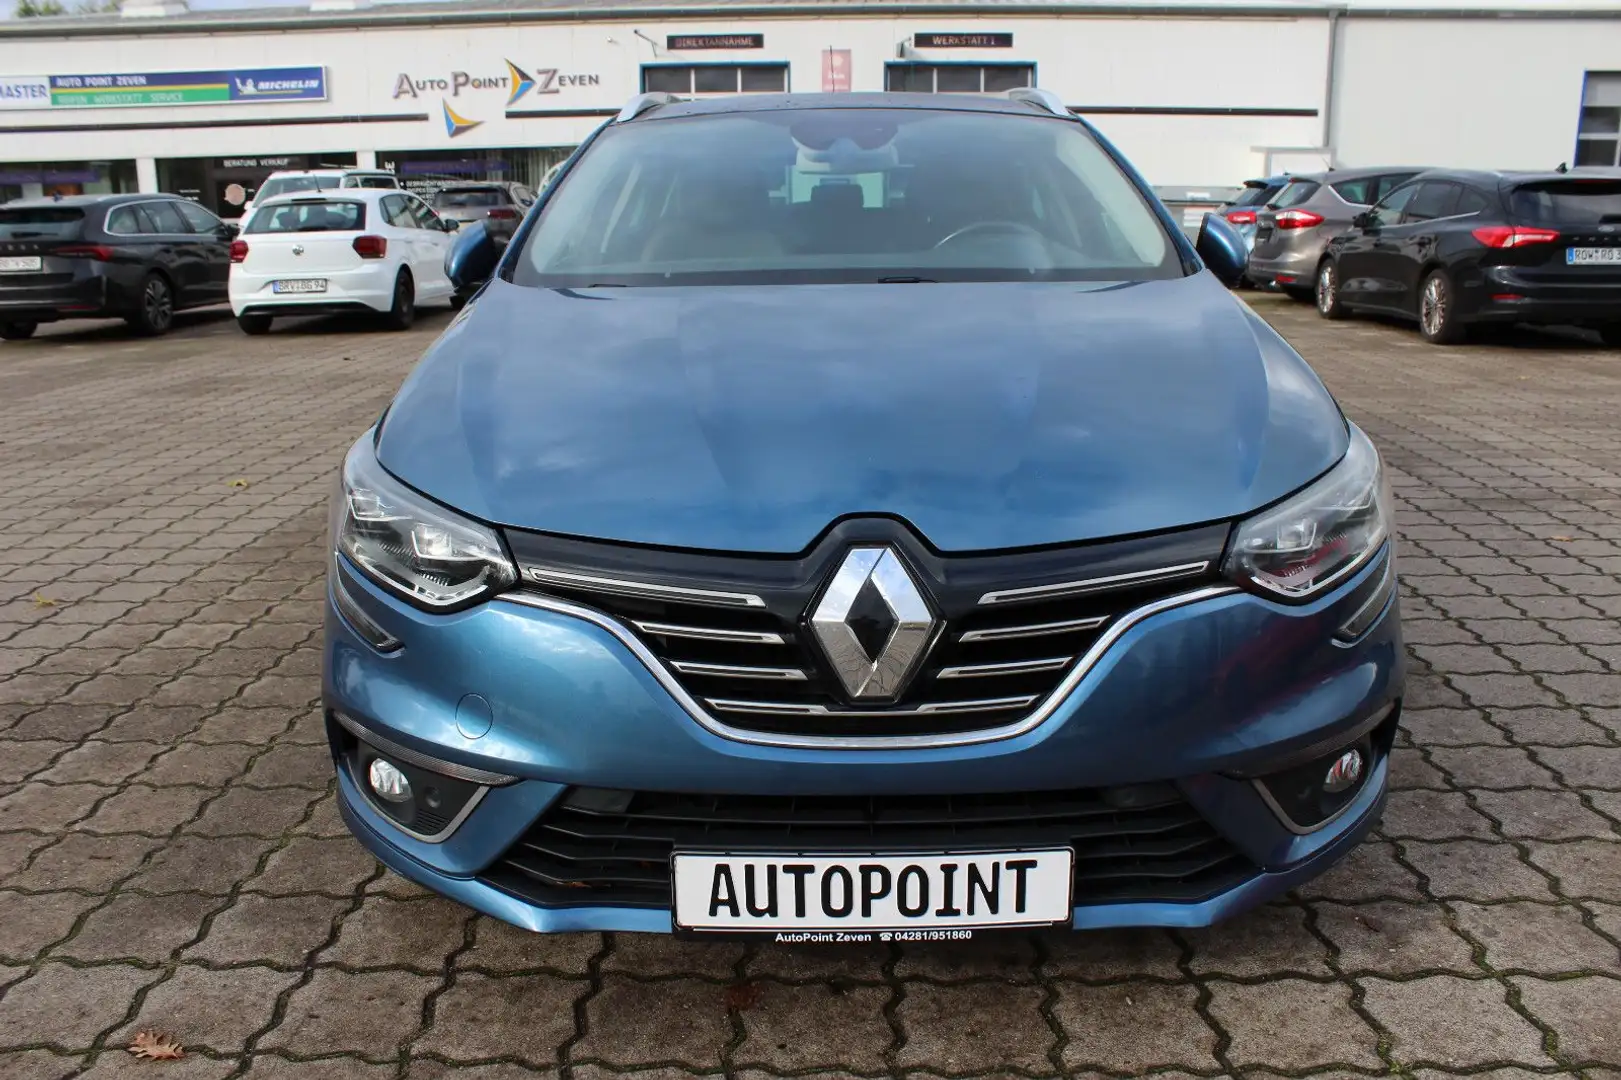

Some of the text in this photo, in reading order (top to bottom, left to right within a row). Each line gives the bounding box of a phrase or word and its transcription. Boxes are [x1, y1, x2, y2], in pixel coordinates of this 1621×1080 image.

[675, 36, 755, 49] DIREKTANNAHME
[932, 35, 986, 45] WERKSTATT
[56, 76, 147, 87] AUTO POINT ZEVEN
[257, 79, 320, 90] MICHELIN
[537, 68, 600, 95] ZEVEN
[150, 92, 184, 102] SERVICE
[223, 158, 289, 168] BERATUNG VERKAUF
[708, 859, 1038, 918] AUTOPOINT
[775, 930, 973, 943] AutoPoint Zeven 04281/951860
